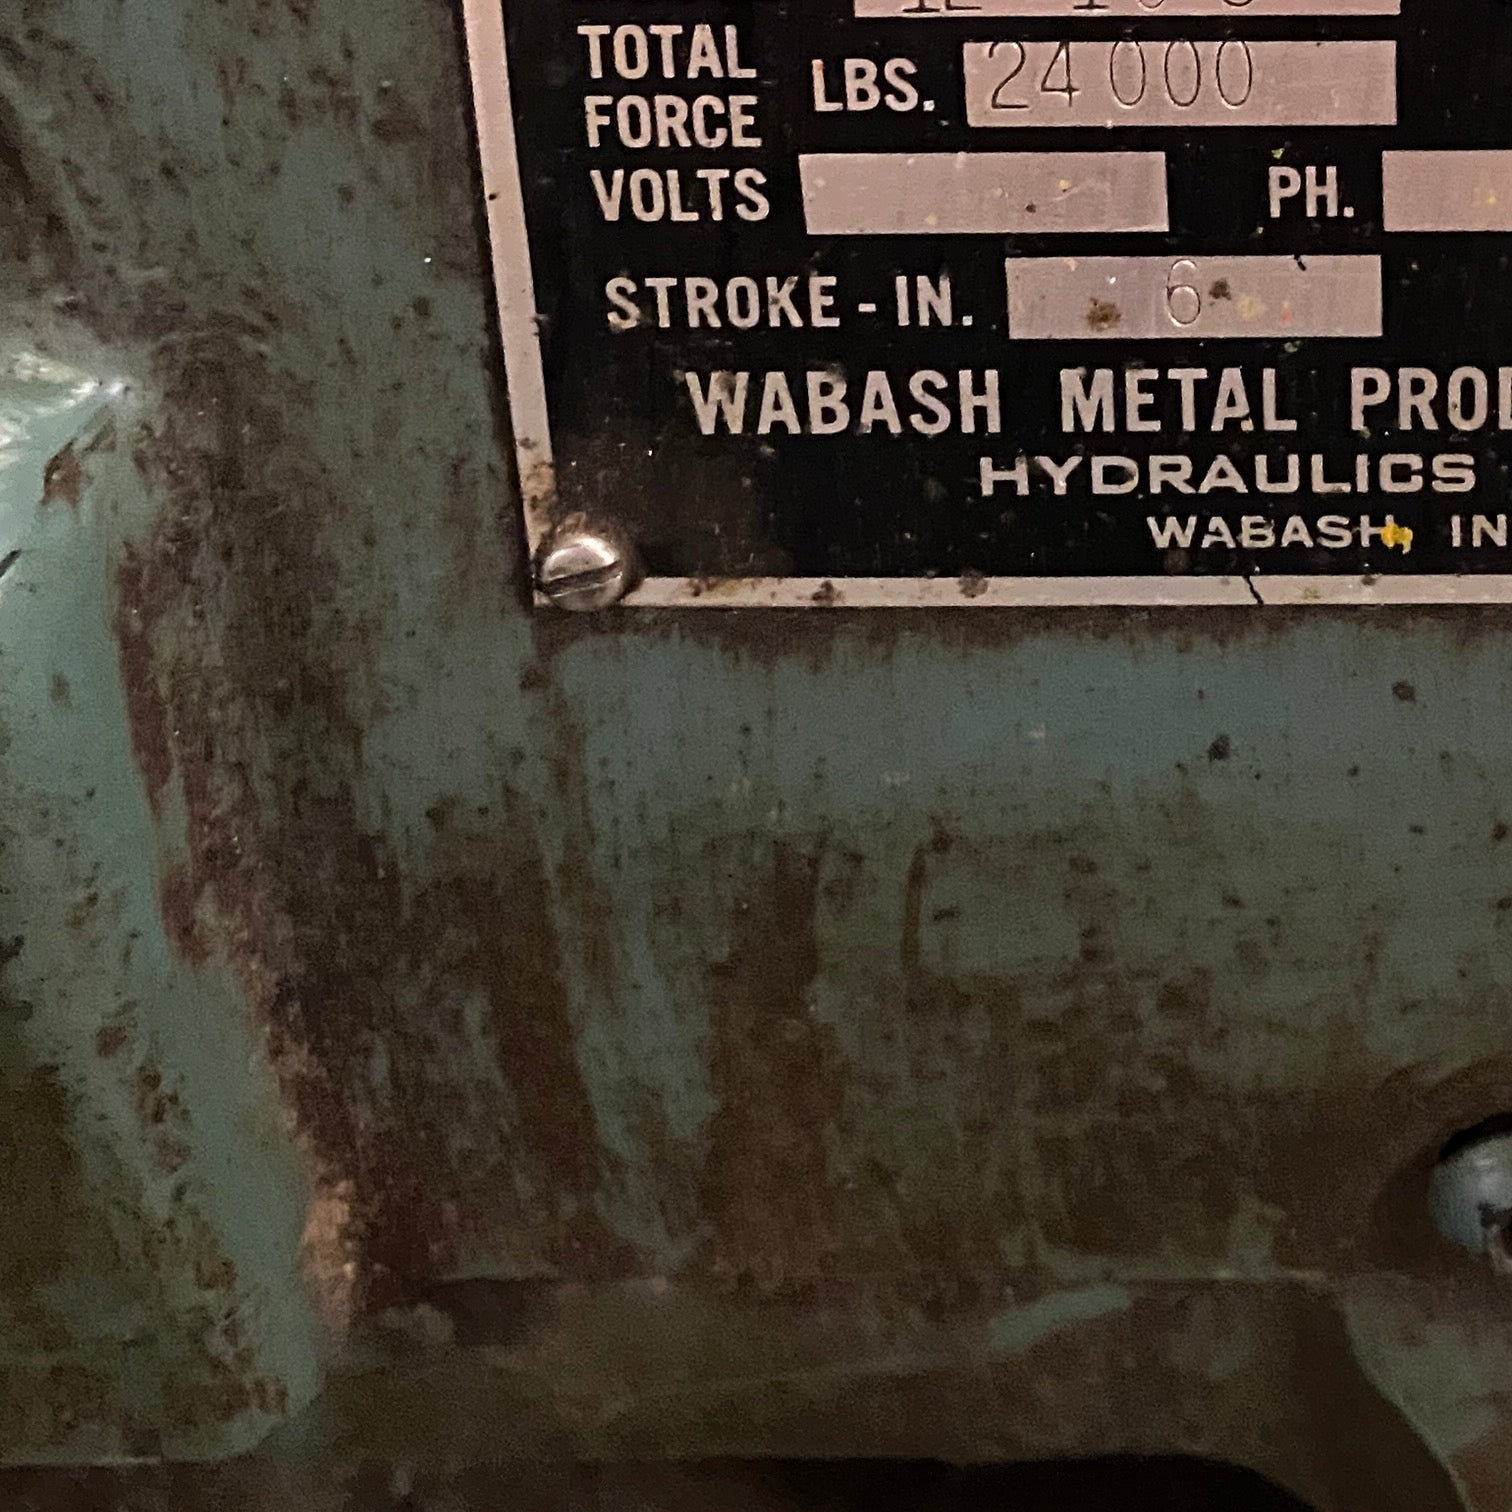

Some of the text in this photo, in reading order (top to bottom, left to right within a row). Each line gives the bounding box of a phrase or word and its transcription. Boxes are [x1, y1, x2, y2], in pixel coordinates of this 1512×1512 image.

[577, 24, 757, 79] TOTAL
[810, 58, 936, 113] LBS.
[584, 95, 762, 150] FORCE
[590, 168, 770, 223] VOLTS
[1268, 166, 1354, 219] PH.
[1165, 258, 1201, 326] 6
[686, 369, 1001, 436] WABASH
[1059, 368, 1298, 433] METAL
[979, 453, 1476, 497] HYDRAULICS
